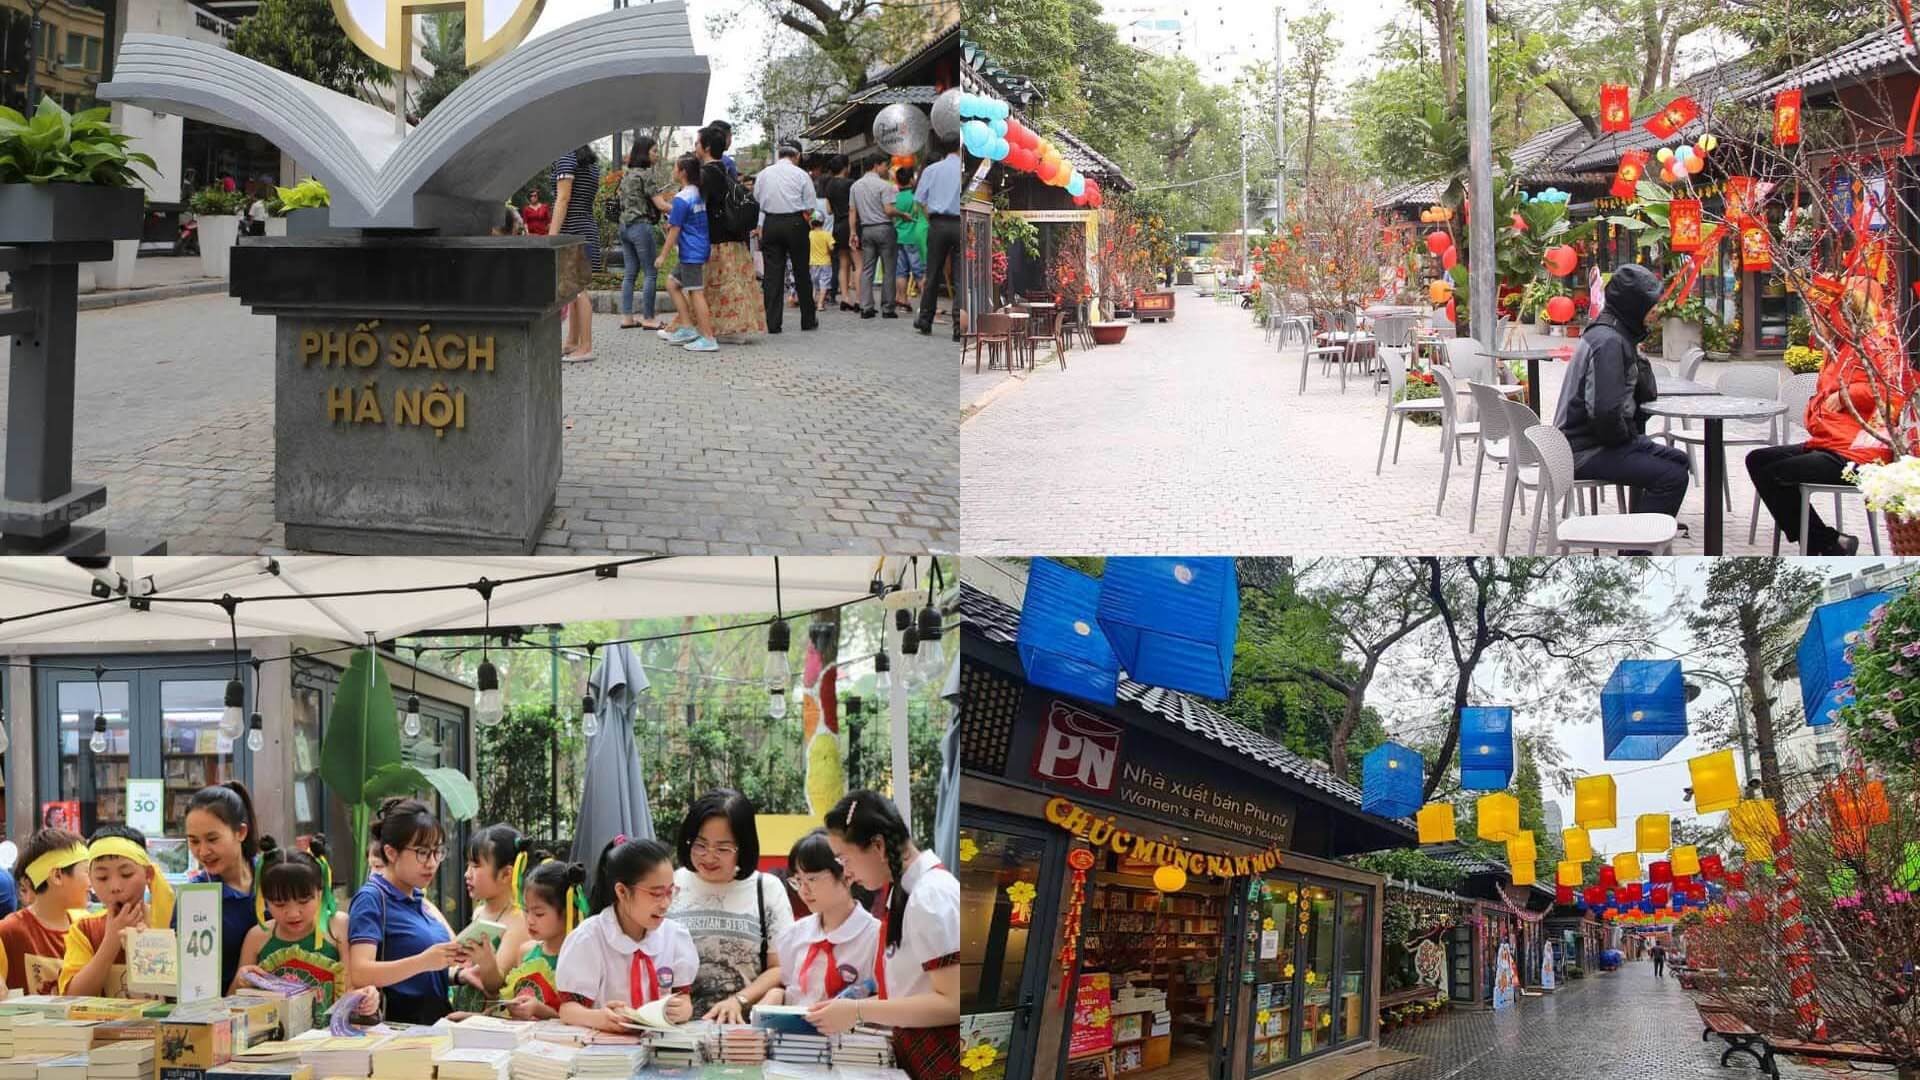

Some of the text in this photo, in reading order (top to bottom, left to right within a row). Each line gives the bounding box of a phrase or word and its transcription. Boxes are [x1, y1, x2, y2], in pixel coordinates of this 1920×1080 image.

[301, 320, 495, 371] PHỐ SÁCH
[394, 382, 465, 438] NỘI
[1038, 726, 1117, 790] PN
[1123, 762, 1164, 791] Nhà
[1170, 782, 1208, 804] xuất
[1044, 796, 1131, 854] CHÚC
[1130, 835, 1205, 876] MỪNG
[1206, 850, 1250, 878] NĂM
[1120, 787, 1190, 818] Women's
[1194, 808, 1253, 836] Publishing
